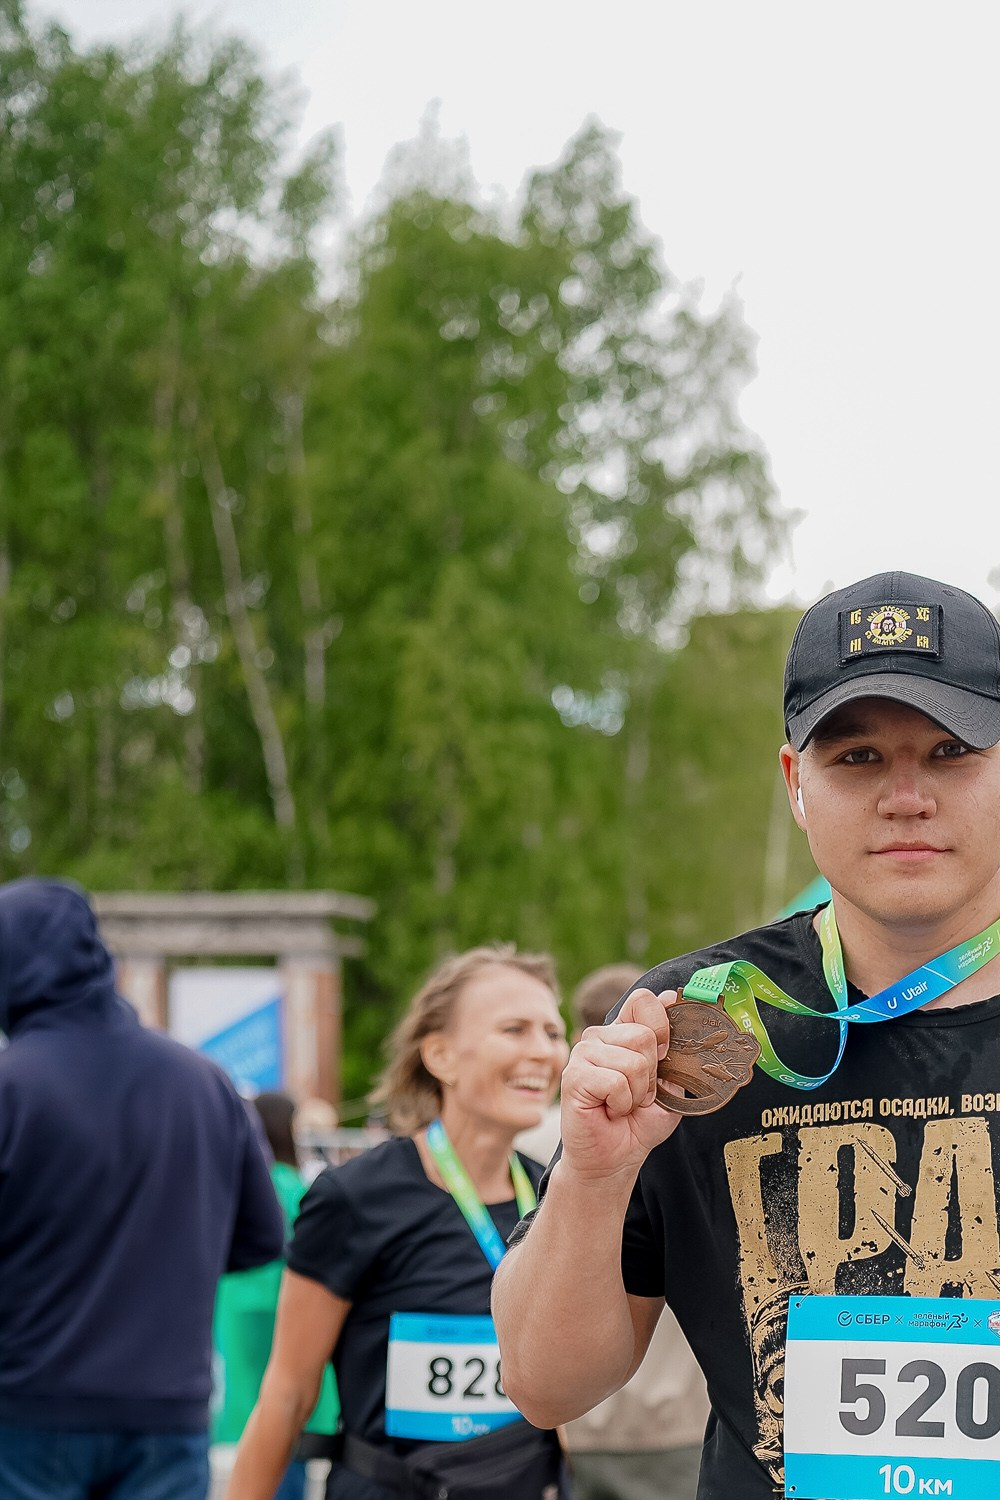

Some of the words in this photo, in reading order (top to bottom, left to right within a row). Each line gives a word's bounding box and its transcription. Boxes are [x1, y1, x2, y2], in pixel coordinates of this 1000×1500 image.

[901, 980, 929, 1002] Utair
[761, 1098, 874, 1128] ОЖИДАЮТСЯ
[879, 1096, 955, 1119] ОСАДКИ,
[855, 1313, 891, 1325] СБЕР
[912, 1311, 950, 1321] зелёный
[908, 1320, 947, 1330] марафон
